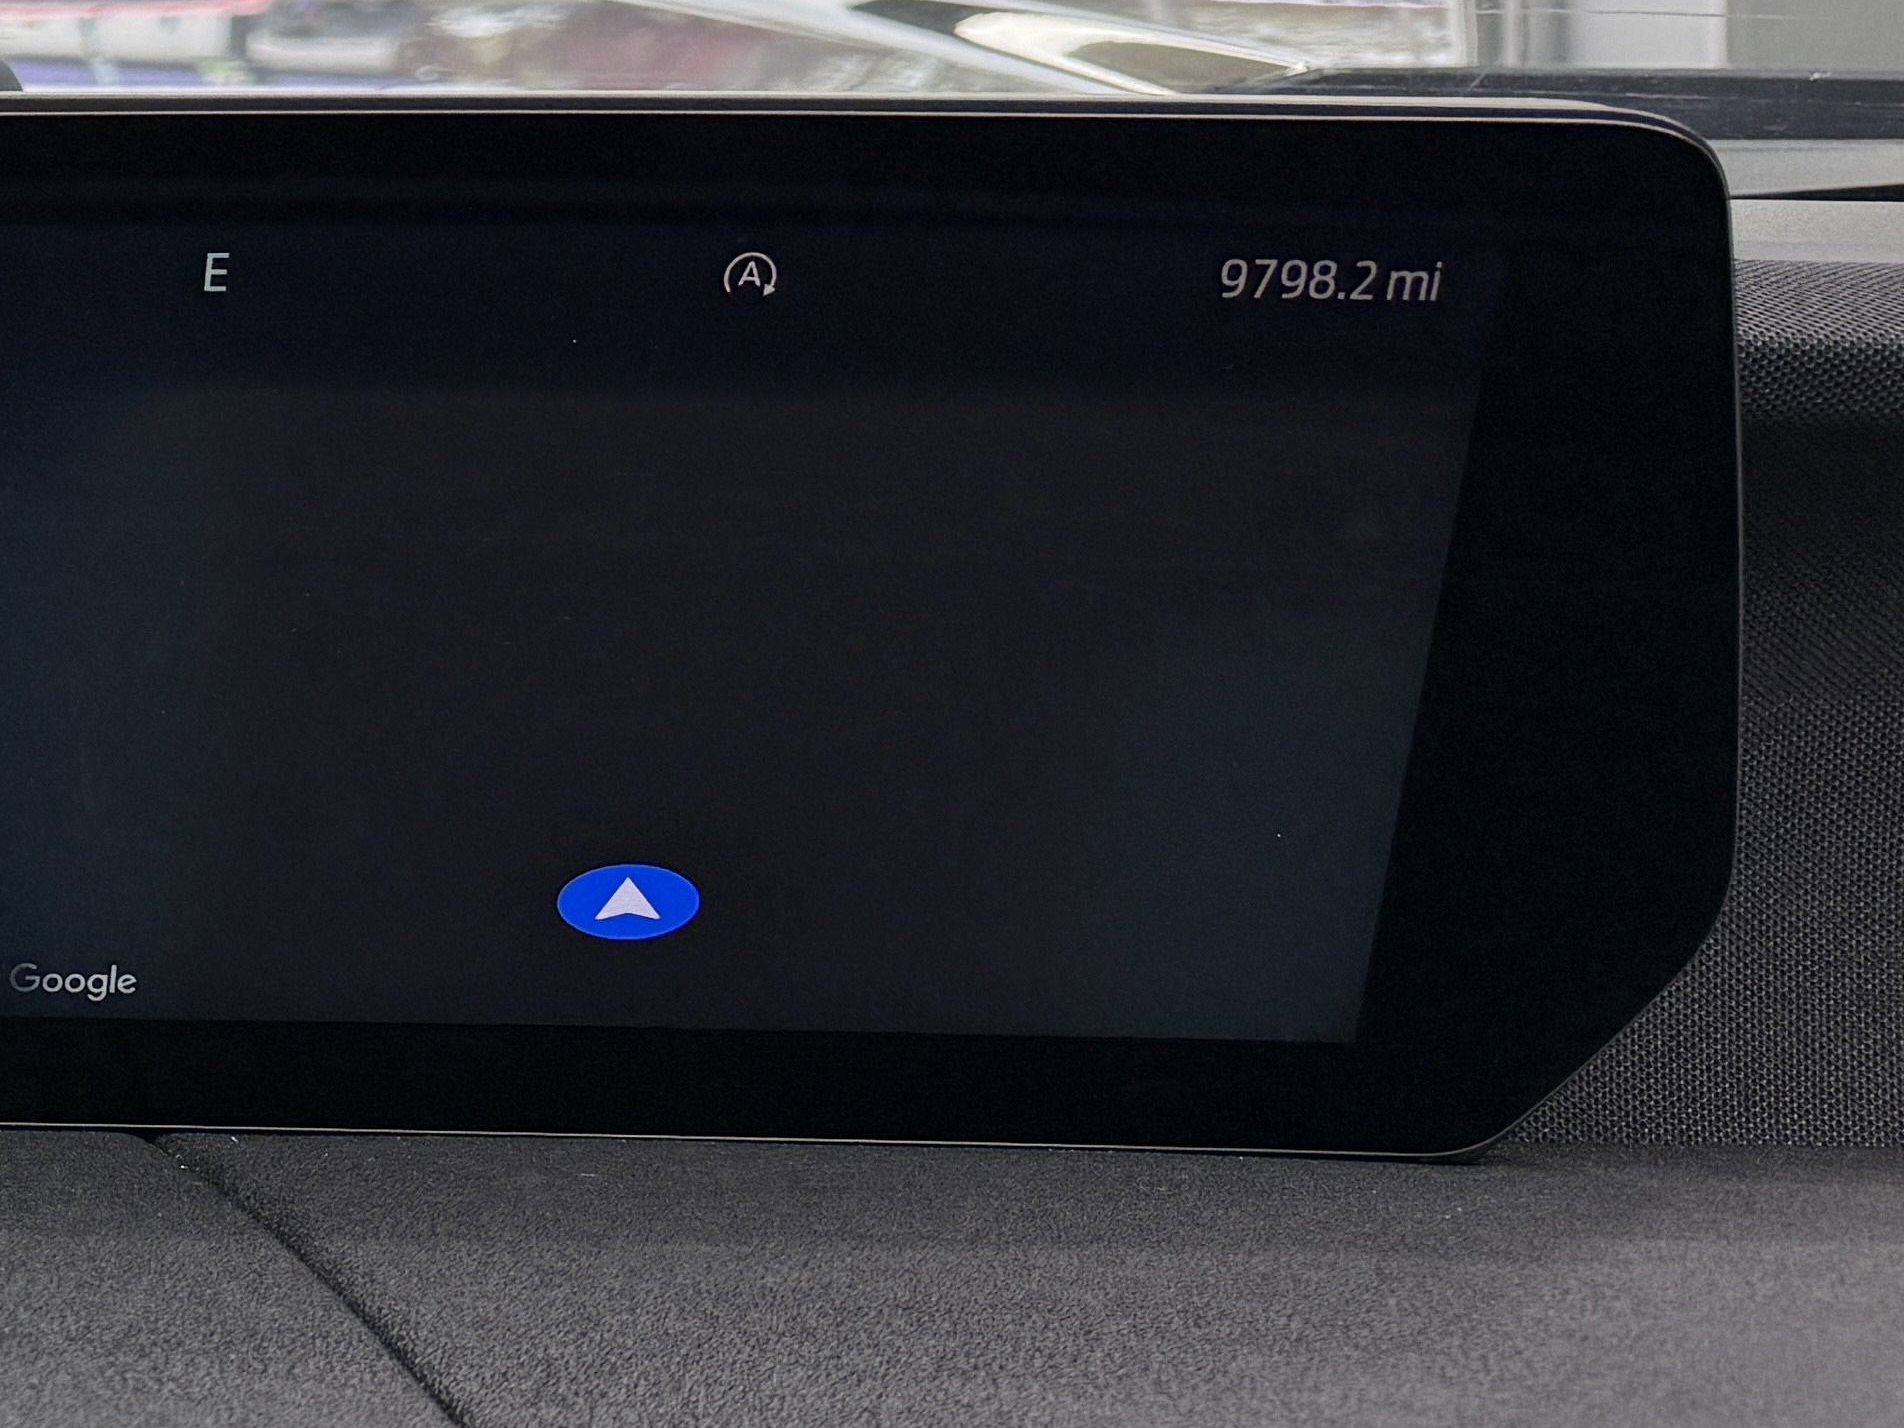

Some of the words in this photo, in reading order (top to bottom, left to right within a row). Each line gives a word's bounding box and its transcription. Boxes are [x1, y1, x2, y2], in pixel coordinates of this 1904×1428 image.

[203, 252, 230, 292] E
[1220, 259, 1378, 301] 9798.2
[1386, 261, 1443, 301] mi
[9, 963, 137, 1002] Google
